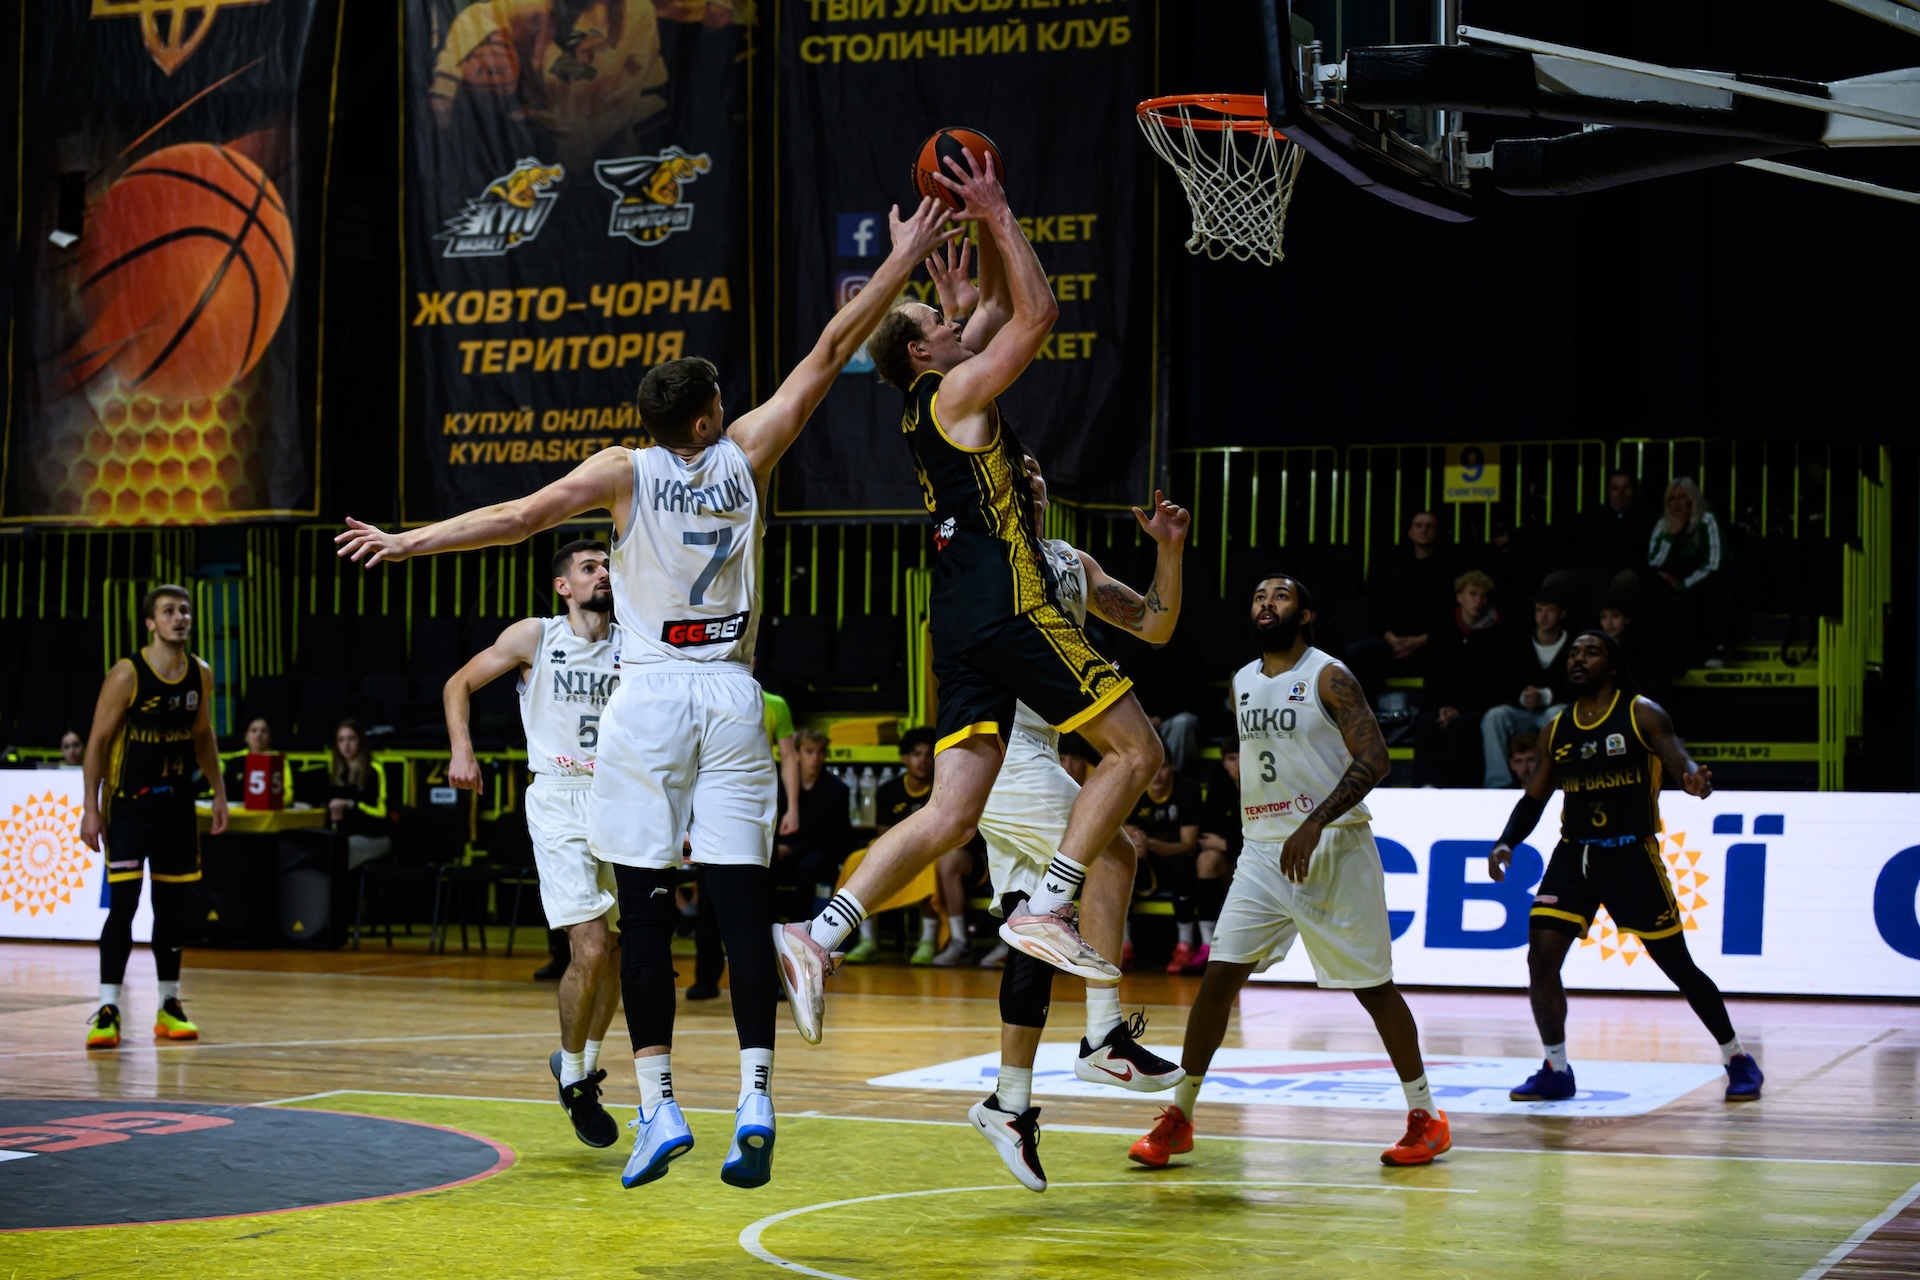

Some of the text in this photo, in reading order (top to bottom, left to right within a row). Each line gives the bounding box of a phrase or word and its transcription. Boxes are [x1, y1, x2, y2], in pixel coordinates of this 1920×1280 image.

[800, 15, 1132, 64] СТОЛИЧНИЙ КЛУБ
[412, 277, 732, 327] ЖОВТО-ЧОРНА
[458, 331, 685, 375] ТЕРИТОРІЯ
[442, 405, 535, 436] КУПУЙ
[1461, 446, 1484, 483] 9
[683, 527, 732, 606] 7
[668, 617, 744, 644] GG.BET
[554, 670, 620, 697] NIKO
[554, 694, 609, 706] BASKE
[579, 715, 600, 748] 5
[1241, 708, 1297, 734] NIKO
[161, 753, 184, 777] 14
[1259, 750, 1277, 783] 3
[248, 770, 267, 795] 5
[271, 771, 282, 795] 5
[1589, 801, 1608, 828] 3
